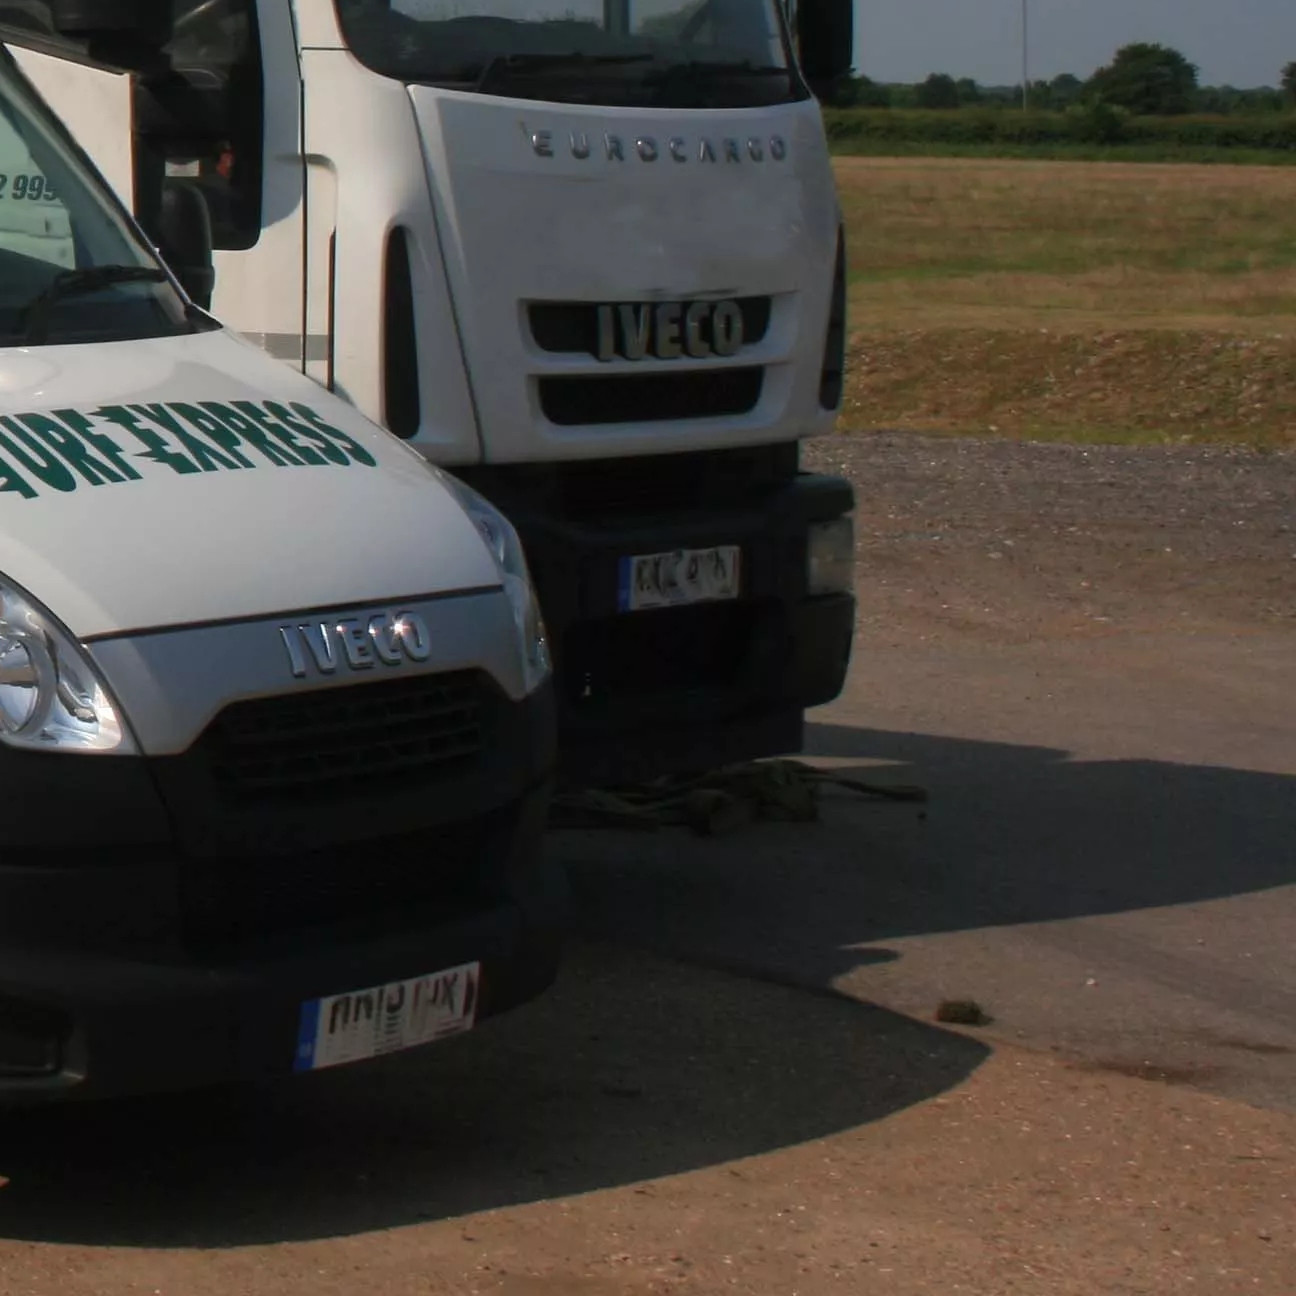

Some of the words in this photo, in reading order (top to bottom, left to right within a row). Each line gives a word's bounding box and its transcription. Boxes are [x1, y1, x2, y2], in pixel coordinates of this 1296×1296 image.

[531, 130, 787, 162] EUROCARGO
[595, 301, 744, 361] IVECO
[89, 400, 377, 474] EXPRESS
[278, 610, 431, 677] IVECO
